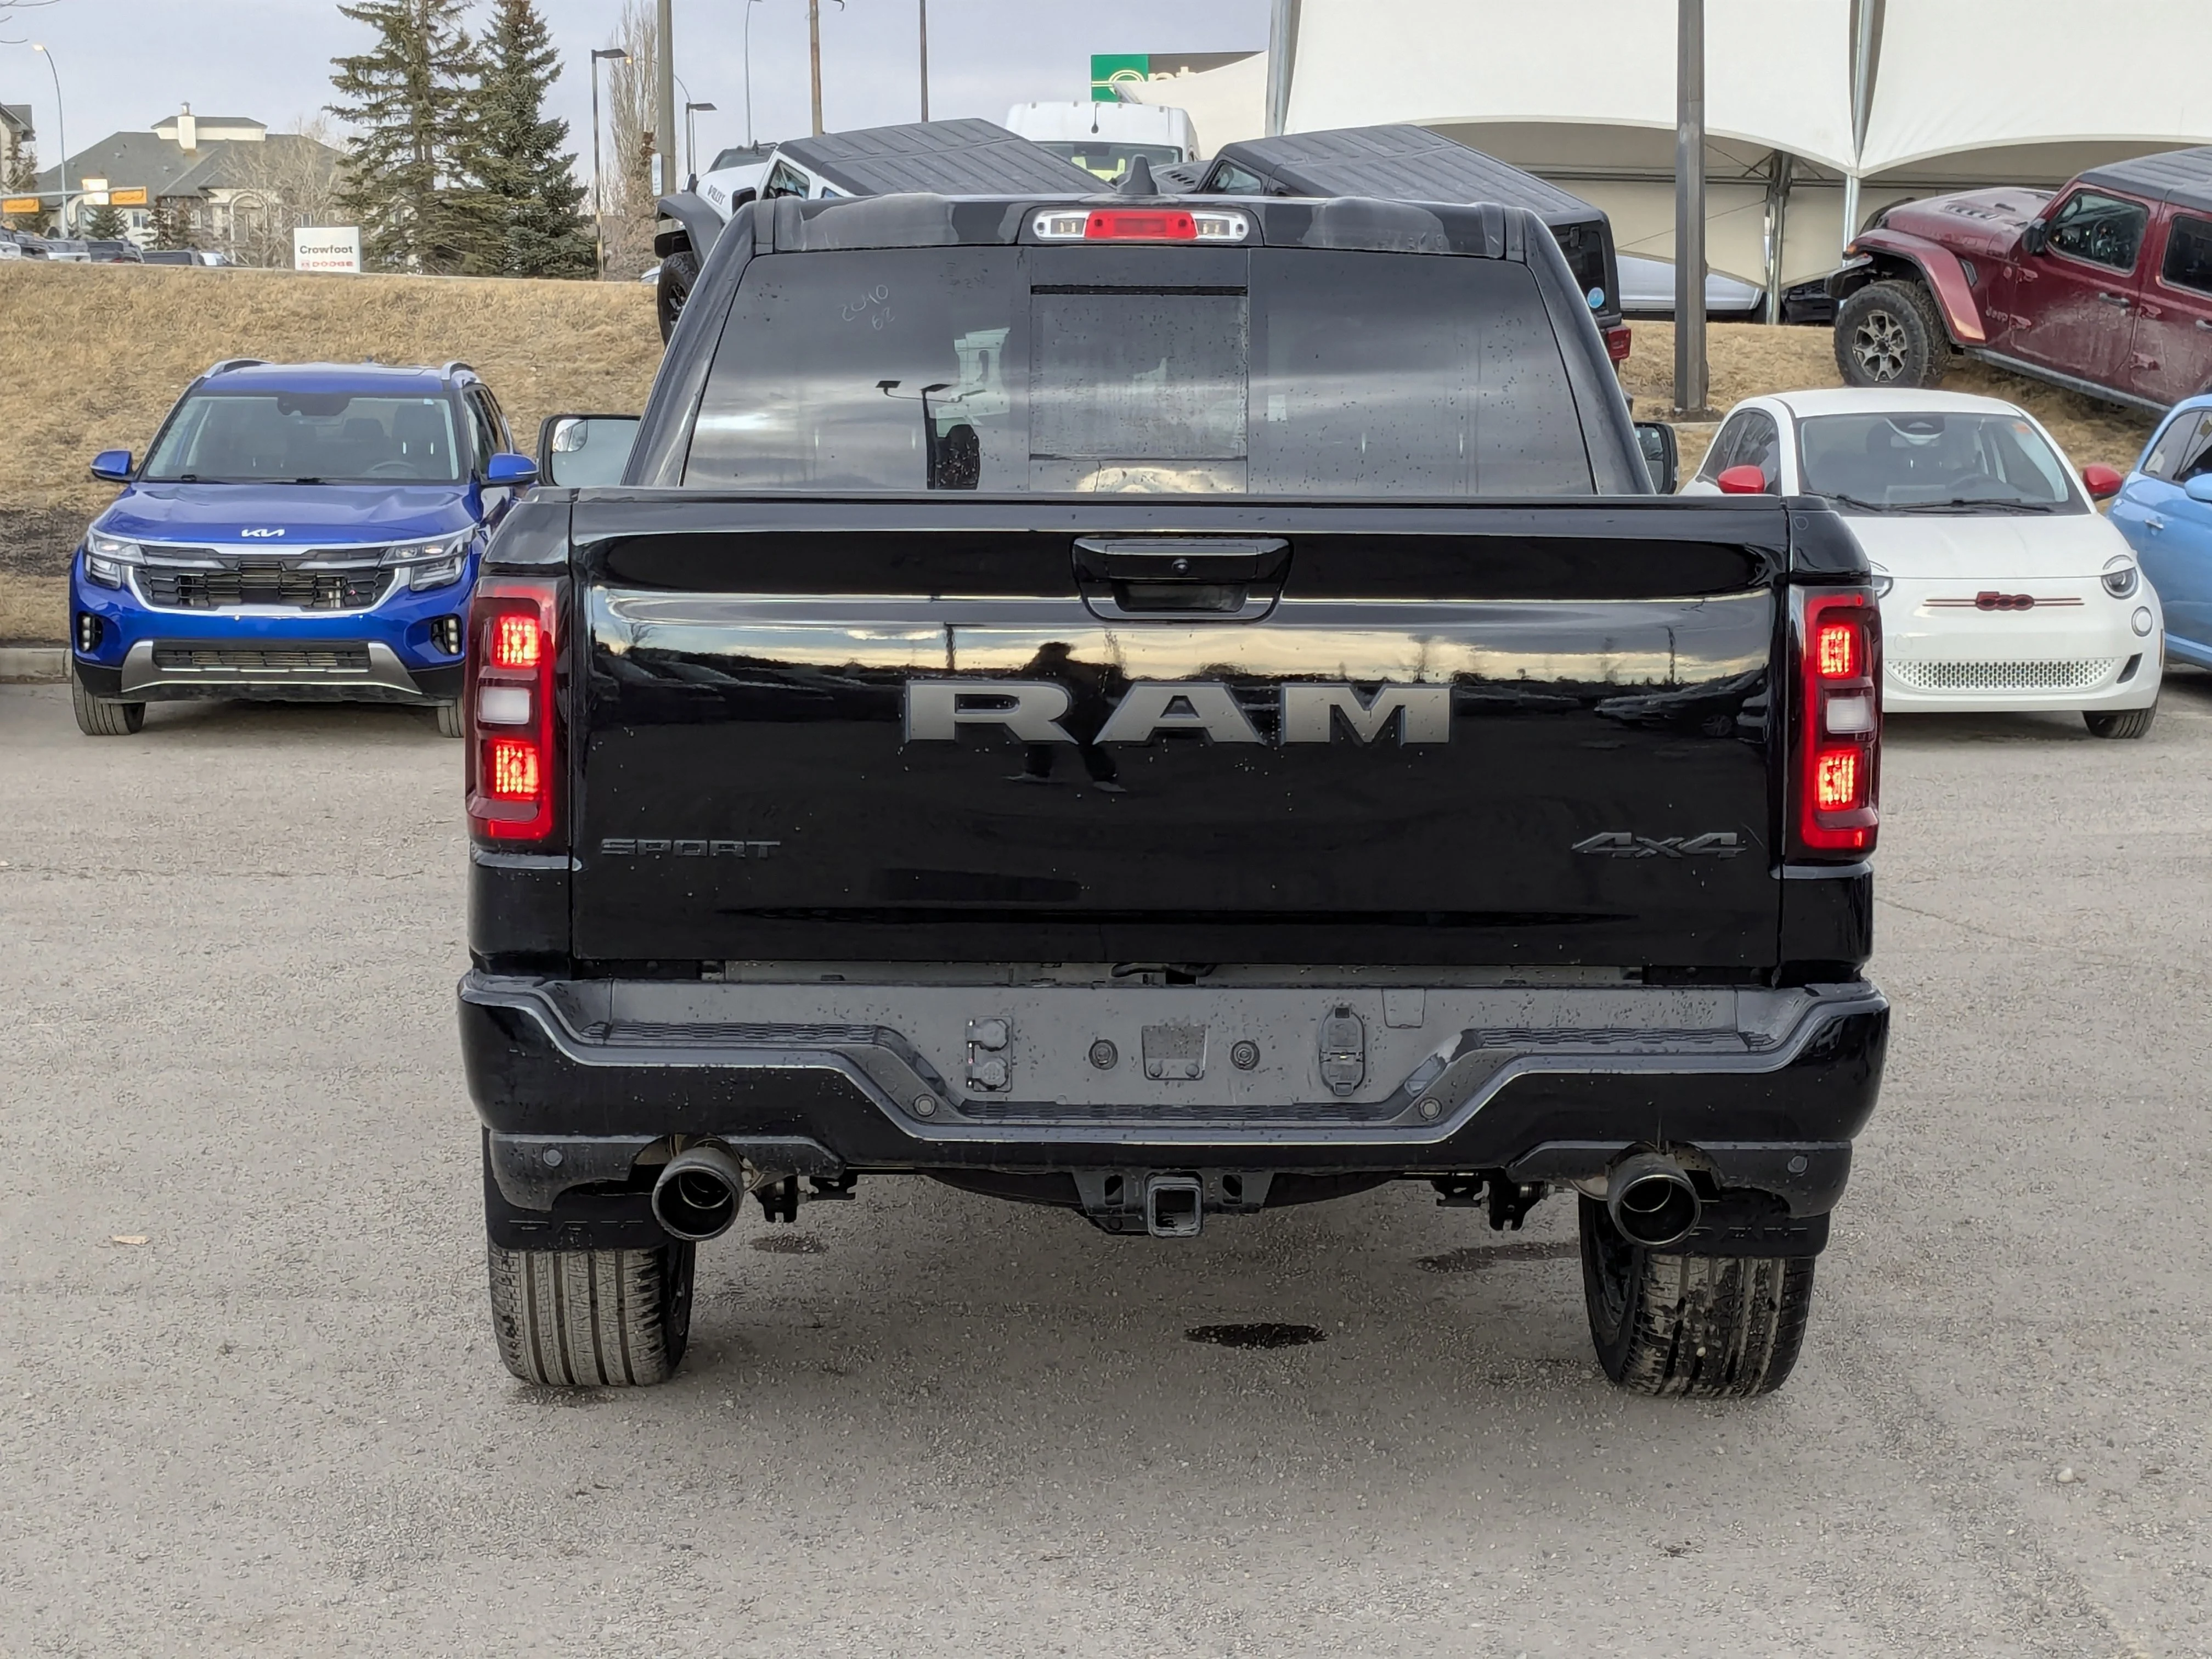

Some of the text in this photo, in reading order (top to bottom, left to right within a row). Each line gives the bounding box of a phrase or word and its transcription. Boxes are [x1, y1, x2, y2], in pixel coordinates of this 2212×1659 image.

[300, 244, 353, 253] Crowfoot
[1985, 306, 2008, 322] Jeep
[1976, 591, 2034, 611] 500
[906, 680, 1452, 745] RAM
[601, 838, 781, 858] SPORT
